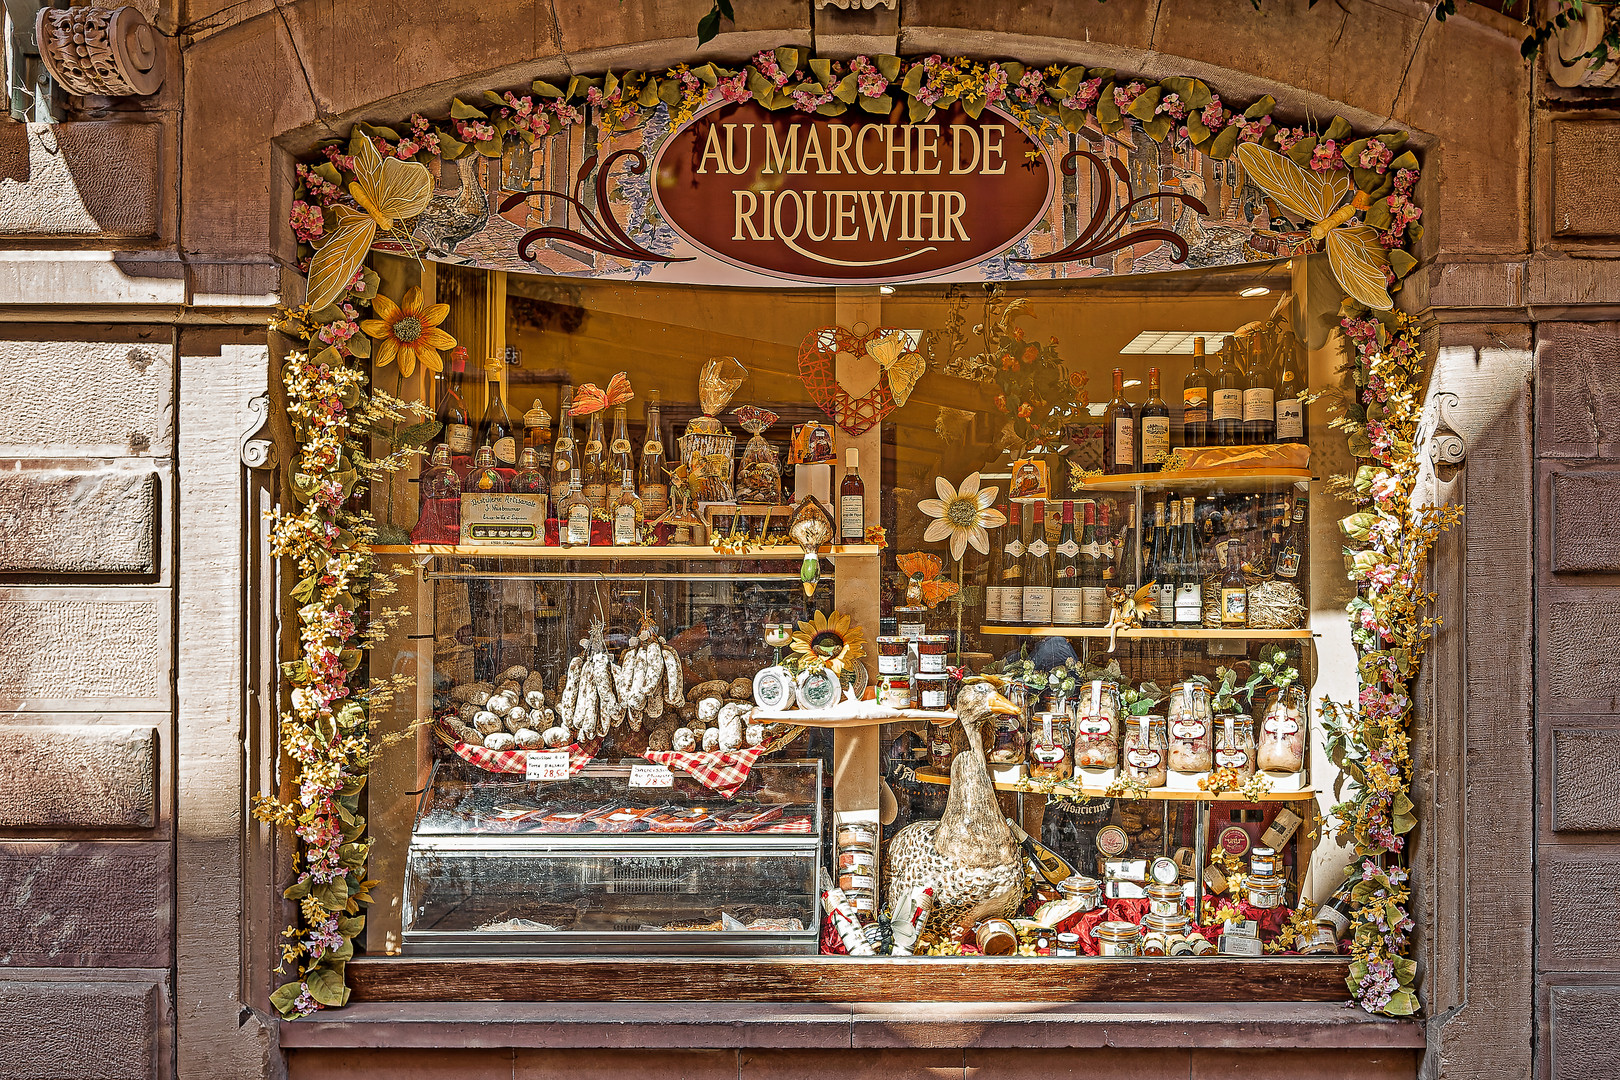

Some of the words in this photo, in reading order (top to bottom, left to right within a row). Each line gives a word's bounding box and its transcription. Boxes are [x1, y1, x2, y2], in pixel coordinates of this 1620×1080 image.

[697, 123, 754, 175] AU
[762, 109, 943, 176] MARCHÉ
[948, 123, 1007, 175] DE
[731, 189, 972, 267] RIQUEWIHR
[1055, 798, 1111, 815] Alsacienne
